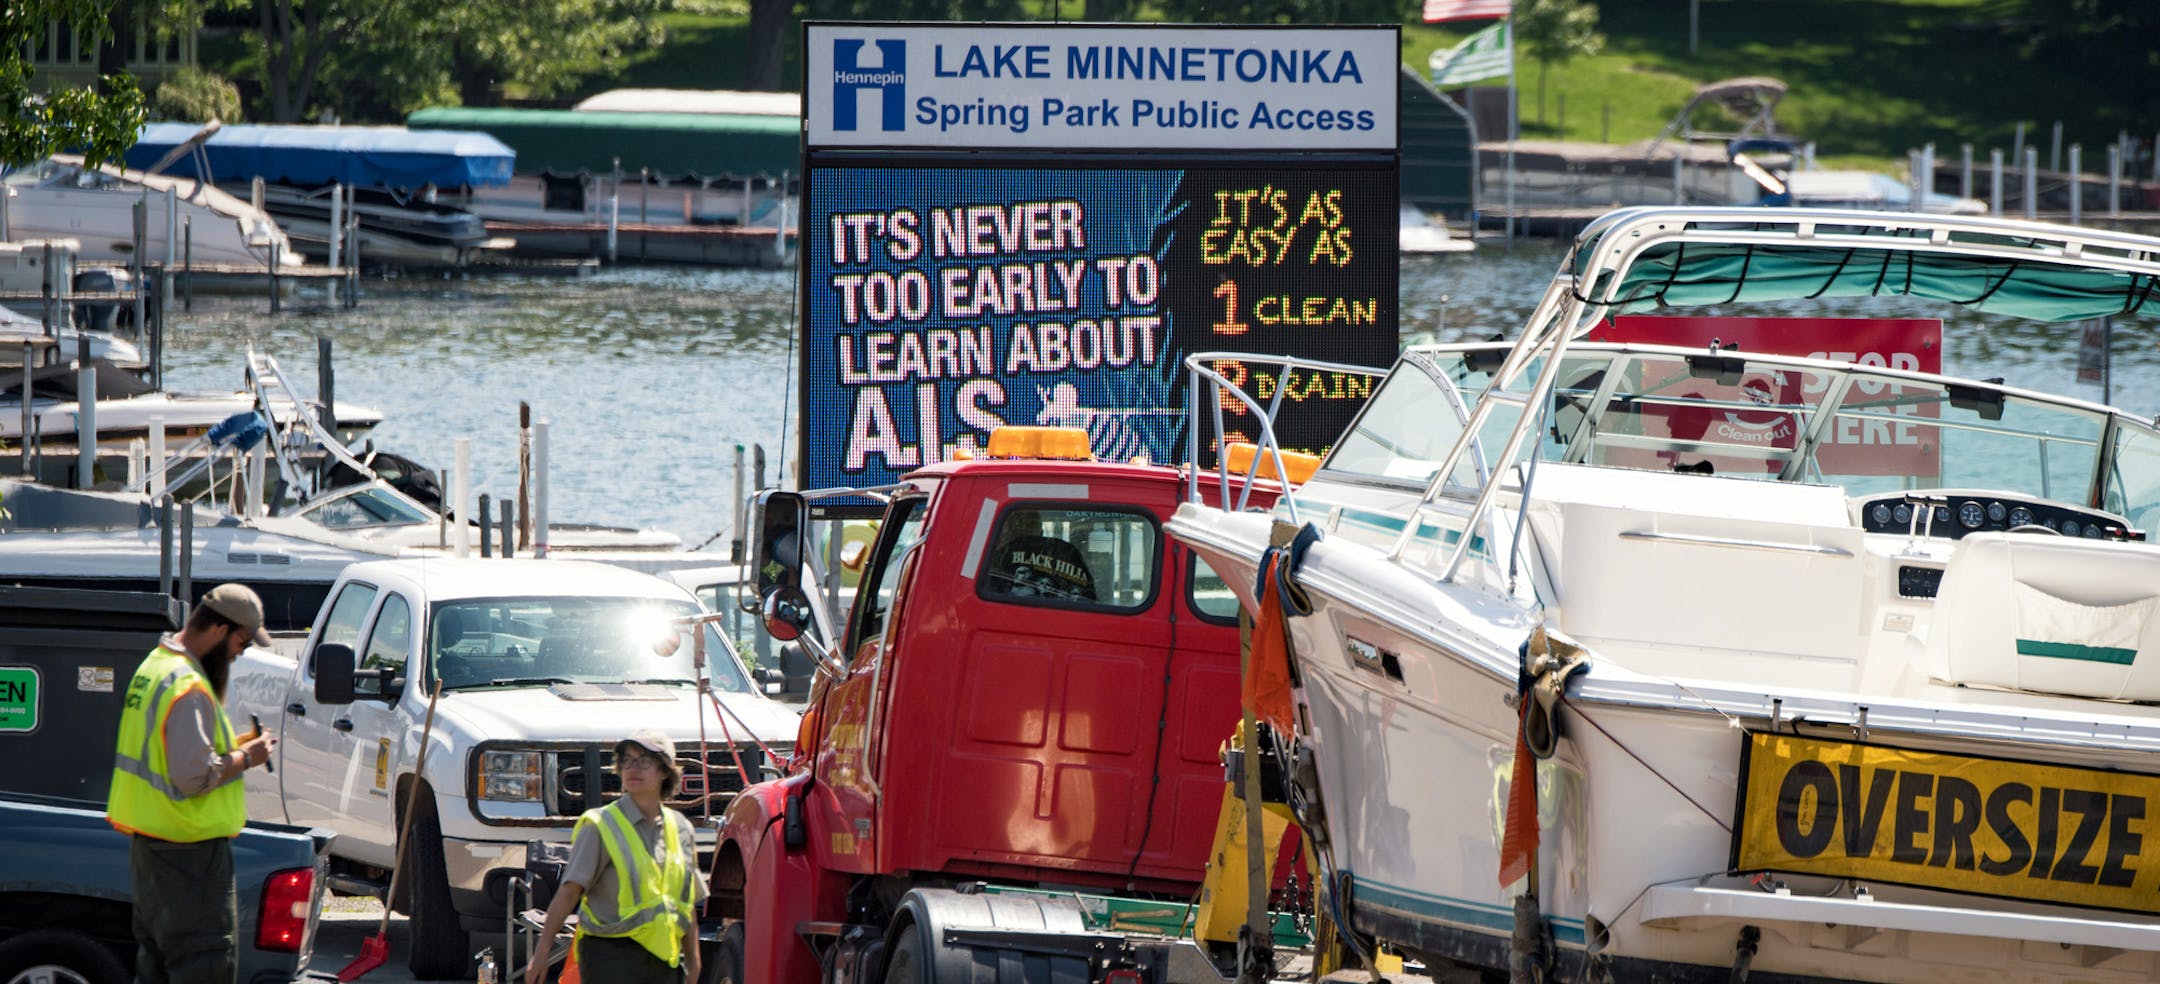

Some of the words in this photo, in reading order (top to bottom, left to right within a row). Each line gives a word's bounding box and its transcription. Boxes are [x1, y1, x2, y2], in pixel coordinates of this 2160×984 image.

[834, 70, 904, 86] Hennepin
[934, 44, 1051, 78] LAKE
[1067, 46, 1363, 84] MINNETONKA
[915, 96, 1029, 133] Spring
[1043, 98, 1120, 127] Park
[1132, 99, 1240, 129] Public
[1248, 101, 1375, 131] Access
[1211, 184, 1289, 229] IT'S
[1300, 190, 1344, 229] AS
[831, 209, 921, 264] IT'S
[932, 201, 1085, 257] NEVER
[1201, 226, 1298, 267] EASY
[1309, 227, 1353, 268] AS
[834, 270, 930, 324] TOO
[941, 259, 1085, 317] EARLY
[1097, 254, 1159, 308] TO
[1212, 280, 1249, 335] 1
[1253, 294, 1377, 326] CLEAN
[839, 325, 994, 384] LEARN
[1007, 315, 1161, 374] ABOUT
[1253, 371, 1373, 402] DRAIN
[1717, 424, 1762, 442] Clean
[1764, 424, 1793, 440] out
[1012, 551, 1052, 569] BLACK
[1775, 759, 2146, 888] OVERSIZE
